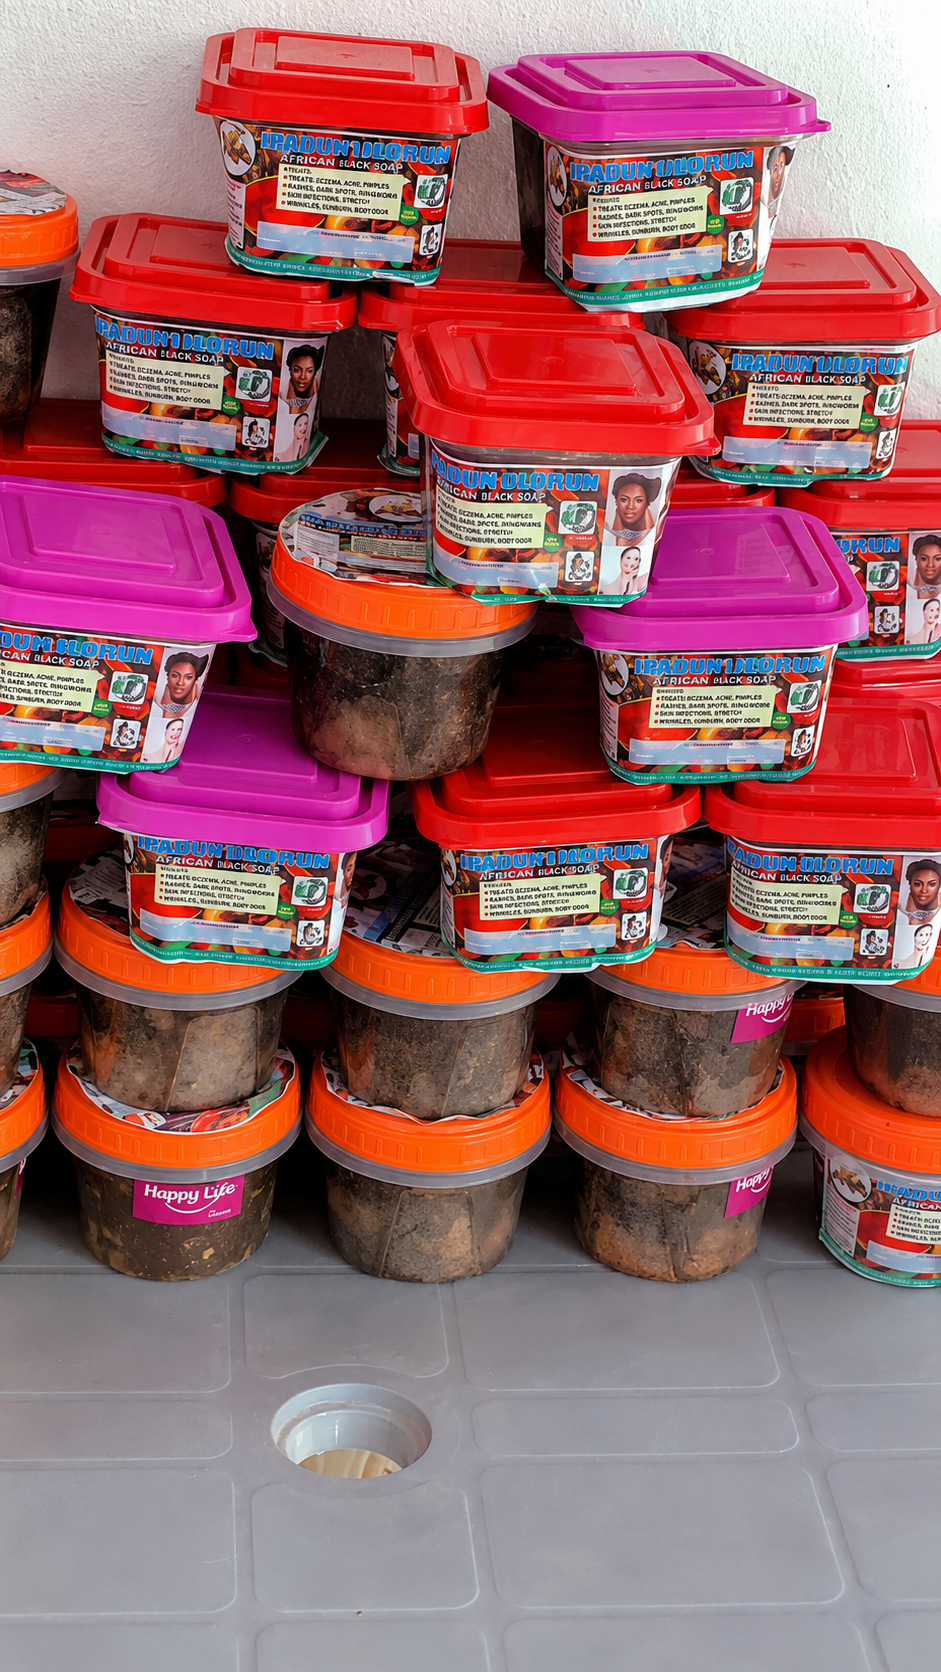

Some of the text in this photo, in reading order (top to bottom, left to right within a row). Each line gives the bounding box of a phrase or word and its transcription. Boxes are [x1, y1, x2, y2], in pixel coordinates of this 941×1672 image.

[280, 155, 335, 167] AFRICAN
[373, 162, 403, 173] SOAP
[589, 175, 707, 194] AFRICAN BLACK SOAP
[106, 342, 157, 357] AFRICAN
[195, 354, 224, 364] SOAP
[750, 373, 800, 383] AFRICAN
[840, 375, 866, 384] SOAP
[481, 491, 513, 501] BLACK
[69, 659, 99, 669] SOAP
[653, 676, 709, 686] AFRICAN
[746, 675, 776, 685] SOAP
[156, 856, 214, 868] AFRICAN
[251, 864, 280, 874] SOAP
[480, 869, 534, 881] AFRICAN
[813, 874, 842, 884] SOAP
[746, 996, 786, 1016] Happy
[144, 1182, 236, 1205] Happy Life
